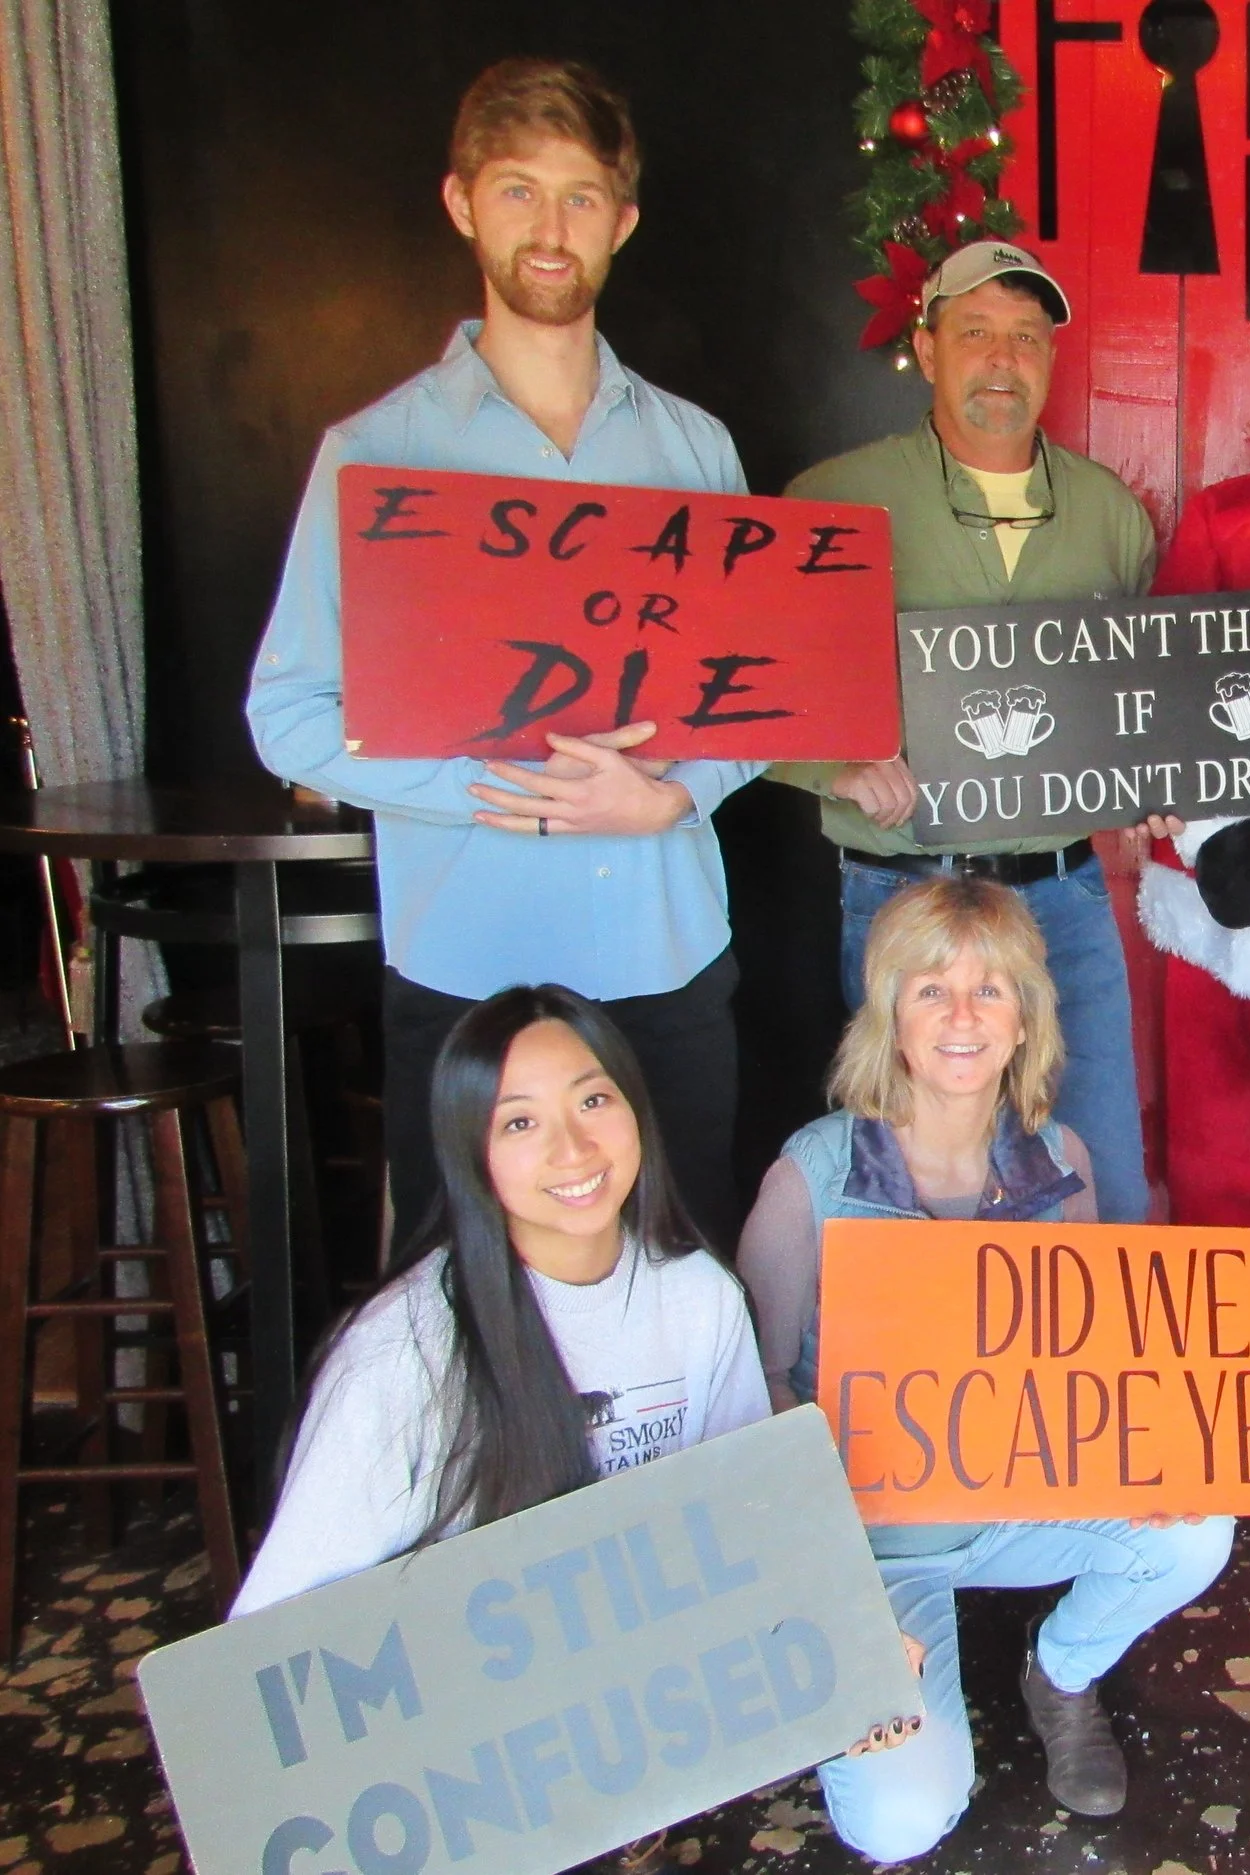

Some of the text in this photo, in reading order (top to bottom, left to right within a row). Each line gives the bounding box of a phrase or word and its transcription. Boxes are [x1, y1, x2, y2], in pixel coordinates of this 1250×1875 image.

[358, 486, 871, 580] ESCAPE
[583, 590, 681, 634] OR
[910, 623, 1019, 673] YOU
[1034, 614, 1176, 666] CAN'T
[449, 639, 805, 747] DIE
[1114, 690, 1156, 735] IF
[918, 775, 1024, 826] YOU
[1040, 763, 1181, 817] DON'T
[976, 1242, 1250, 1358] DID WE
[609, 1407, 688, 1451] SMOKY
[839, 1369, 1163, 1492] ESCAPE
[255, 1500, 758, 1769] I'M STILL
[262, 1615, 837, 1875] CONFUSED
